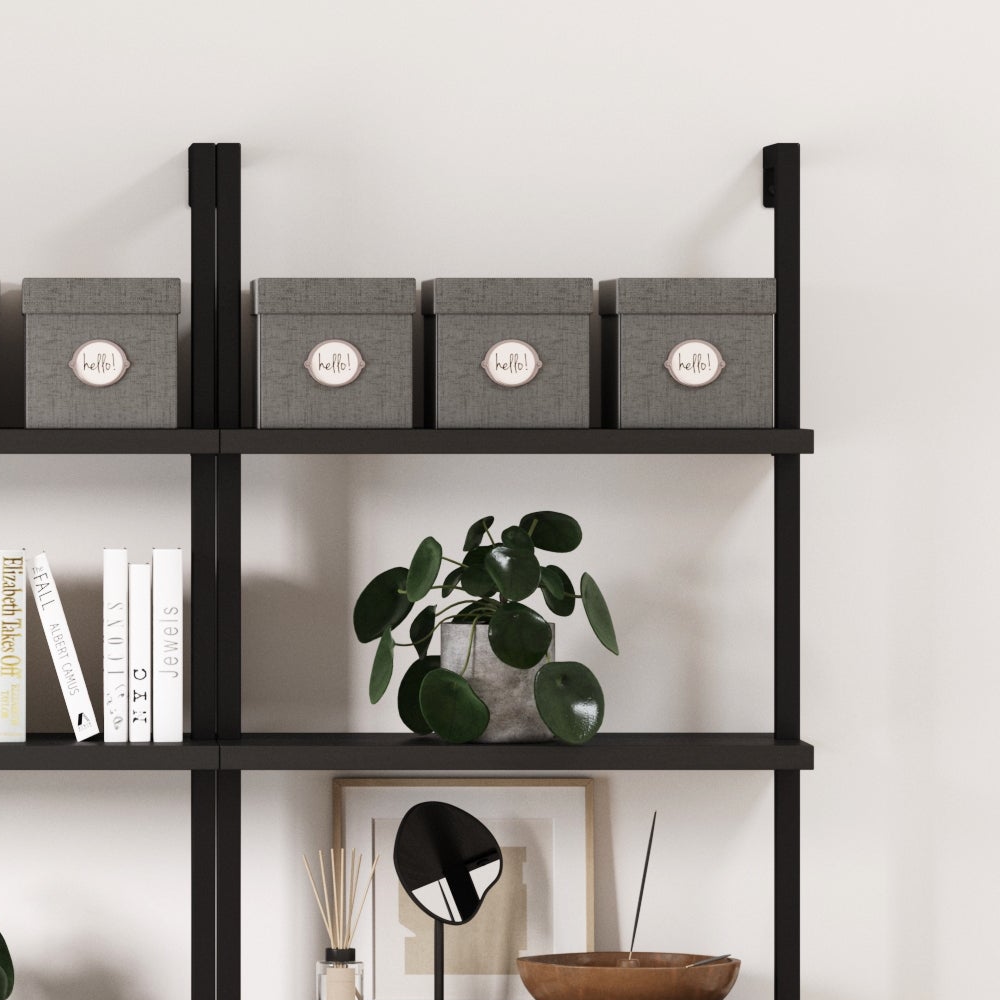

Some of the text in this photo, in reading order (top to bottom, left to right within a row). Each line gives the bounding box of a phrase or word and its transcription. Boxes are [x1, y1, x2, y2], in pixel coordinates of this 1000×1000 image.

[82, 352, 116, 374] hello!
[318, 352, 352, 374] hello!
[495, 352, 529, 374] hello!
[678, 352, 712, 374] hello!
[3, 556, 23, 616] Elizabeth
[33, 572, 55, 611] FALL
[1, 618, 22, 652] Takes
[159, 606, 179, 678] Jewels
[0, 655, 21, 679] Off
[50, 623, 80, 696] ALBERT CAMUS
[132, 668, 147, 724] NYC
